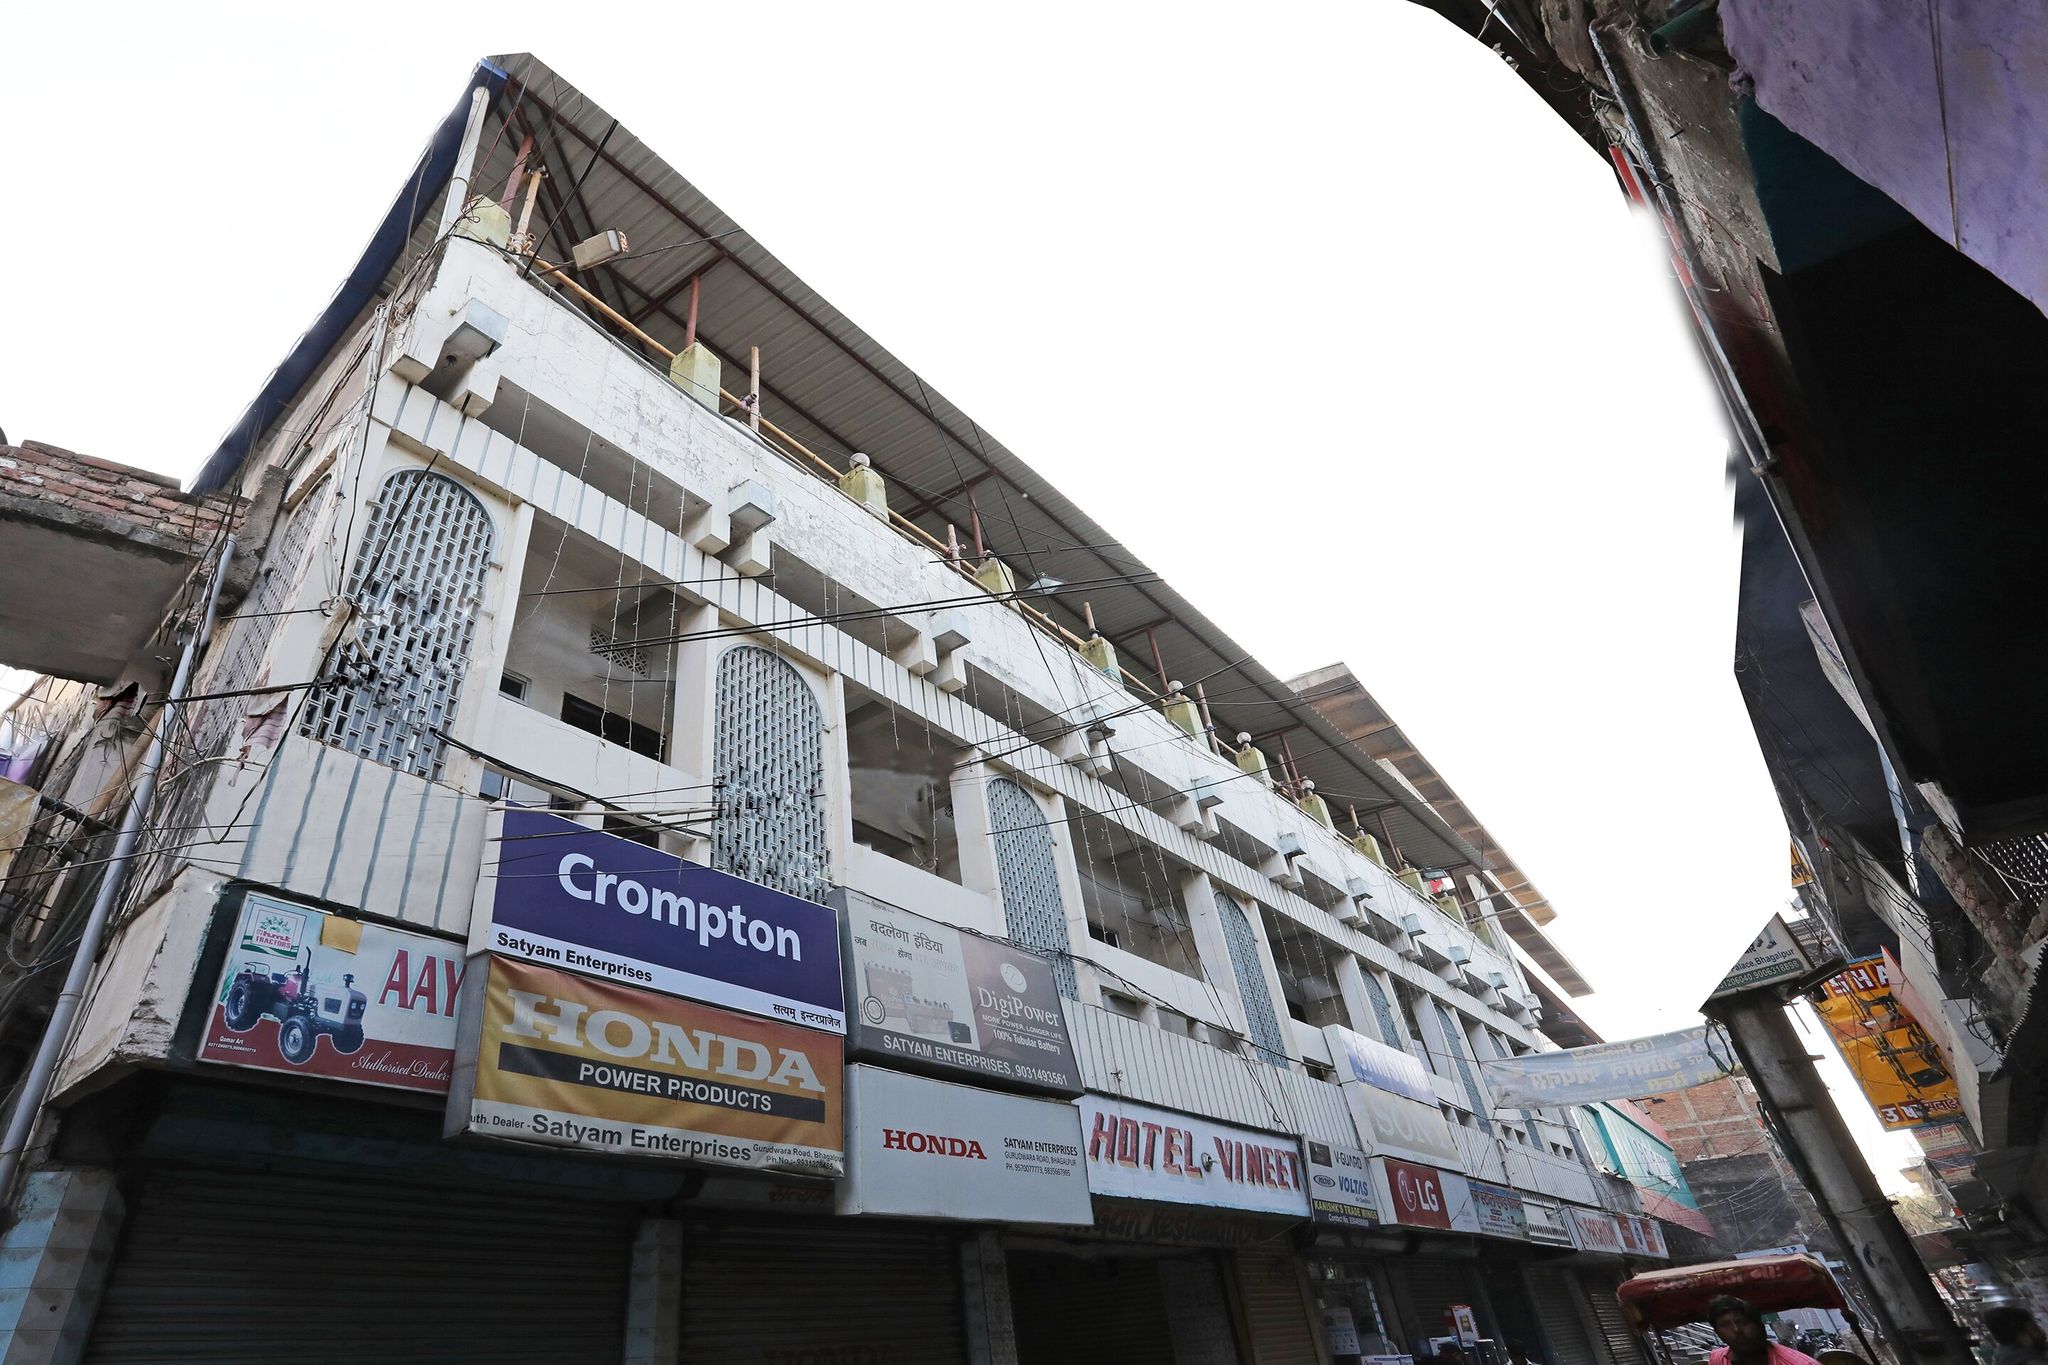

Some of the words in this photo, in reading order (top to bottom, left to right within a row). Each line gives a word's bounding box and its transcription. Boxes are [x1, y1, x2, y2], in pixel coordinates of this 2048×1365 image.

[558, 853, 801, 962] Crompton
[255, 936, 291, 949] TRACTORS
[854, 936, 867, 947] जब
[869, 920, 909, 943] बदलेगा
[913, 932, 944, 954] इंडिया
[497, 932, 561, 961] Satyam
[565, 950, 653, 983] Enterprises
[378, 949, 467, 1018] AAY
[1821, 963, 1888, 996] SHA
[977, 986, 1060, 1027] DigiPower
[501, 989, 825, 1093] HONDA
[982, 1014, 1001, 1025] MORE
[1026, 1025, 1050, 1037] LONGER
[993, 1029, 1012, 1042] 100%
[1013, 1033, 1037, 1048] Tubular
[1038, 1039, 1061, 1055] Battery
[352, 1051, 414, 1076] Authorised
[883, 1035, 932, 1059] SATYAM
[935, 1046, 1014, 1077] ENTERPRISES,
[1015, 1064, 1068, 1086] 9031493561
[579, 1063, 661, 1094] POWER
[667, 1079, 772, 1113] PRODUCTS
[493, 1116, 524, 1129] Dealer
[532, 1114, 622, 1147] Satyam
[629, 1129, 751, 1162] Enterprises
[753, 1143, 792, 1155] Gurudwara
[793, 1148, 813, 1159] Road,
[814, 1151, 844, 1163] Bhagalpur
[883, 1128, 987, 1160] HONDA
[1004, 1137, 1033, 1151] SATYAM
[1034, 1141, 1078, 1157] ENTERPRISES
[1088, 1111, 1202, 1179] HOTEL
[1213, 1135, 1301, 1193] VINEET
[1004, 1151, 1035, 1162] GURUDWARA
[1036, 1155, 1051, 1164] ROAD,
[1051, 1157, 1077, 1167] BHAGALPUR
[1334, 1149, 1362, 1169] V-GUARD
[1338, 1175, 1369, 1197] VOLTAS
[1414, 1178, 1440, 1212] LG
[1344, 1205, 1361, 1217] TRADE
